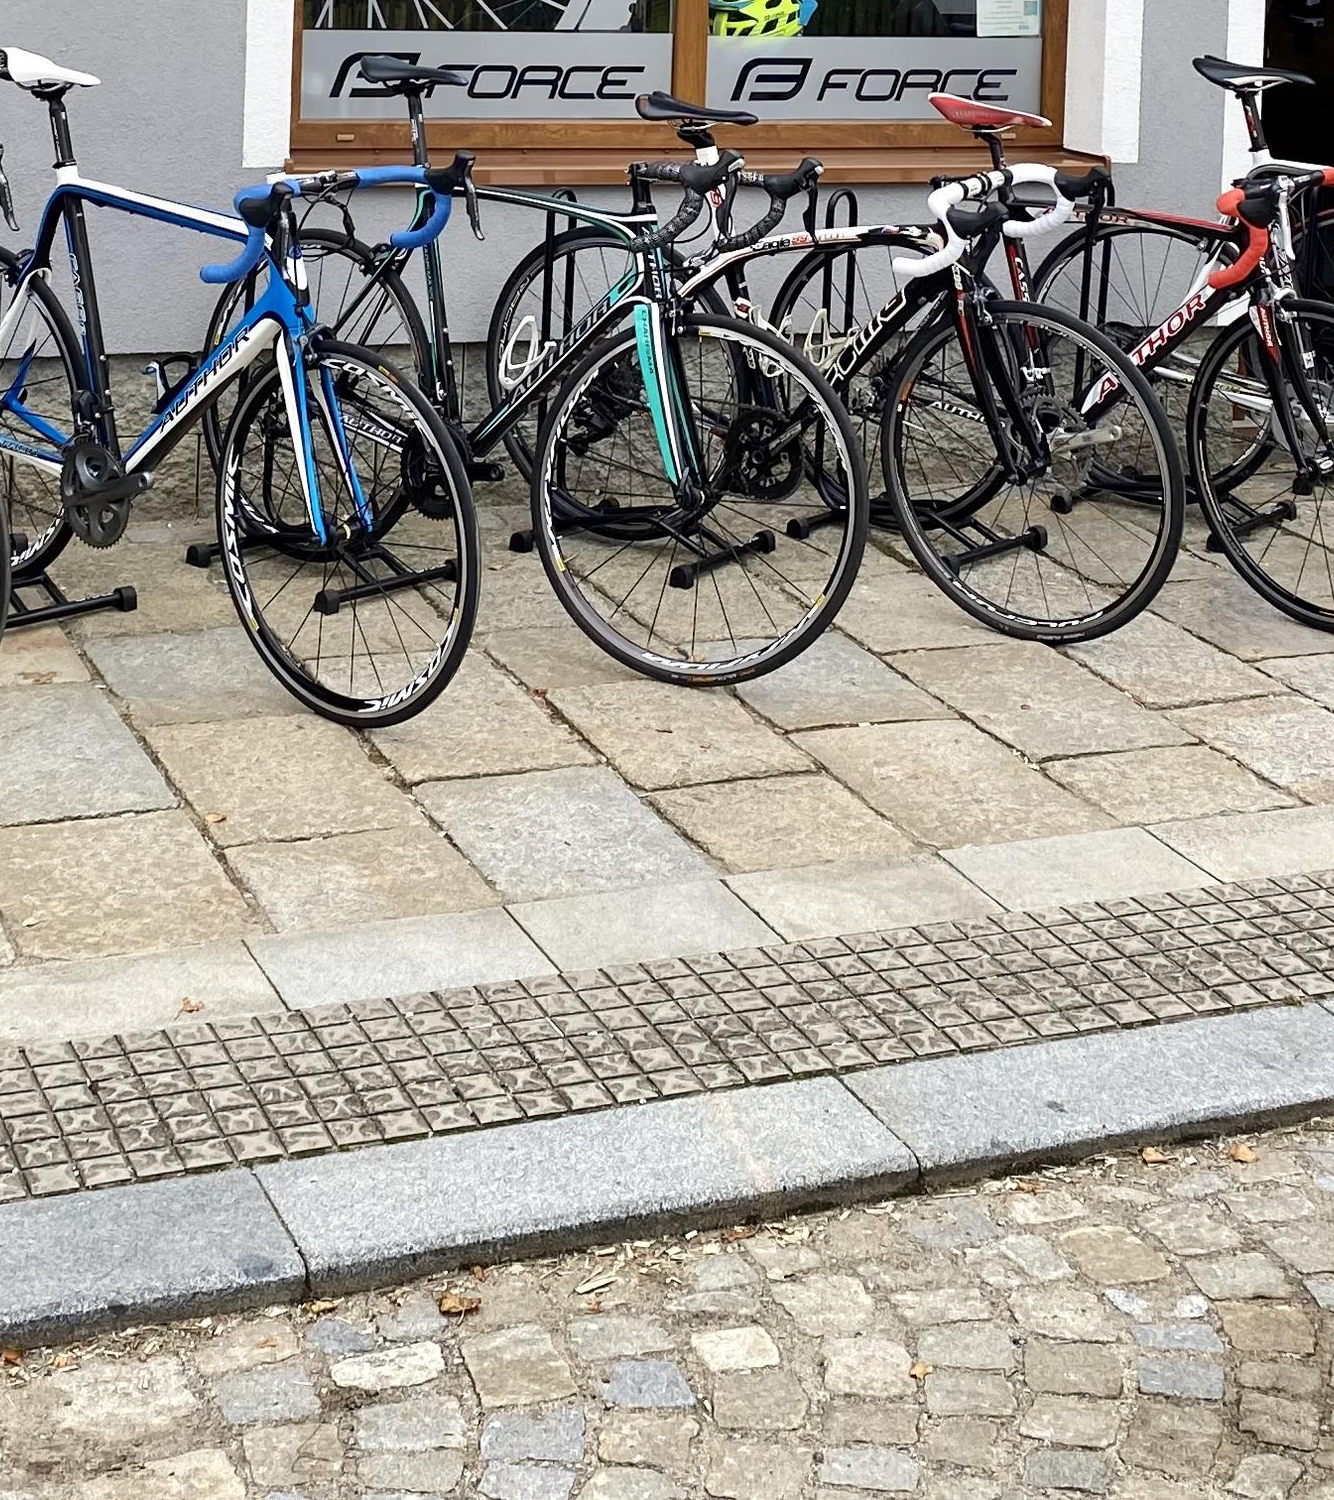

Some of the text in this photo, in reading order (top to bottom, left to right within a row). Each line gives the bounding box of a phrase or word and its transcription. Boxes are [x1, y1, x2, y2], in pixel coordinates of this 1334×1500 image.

[816, 68, 1018, 102] FORCE
[160, 325, 251, 433] AUTHOR
[1097, 293, 1206, 404] ATHOR
